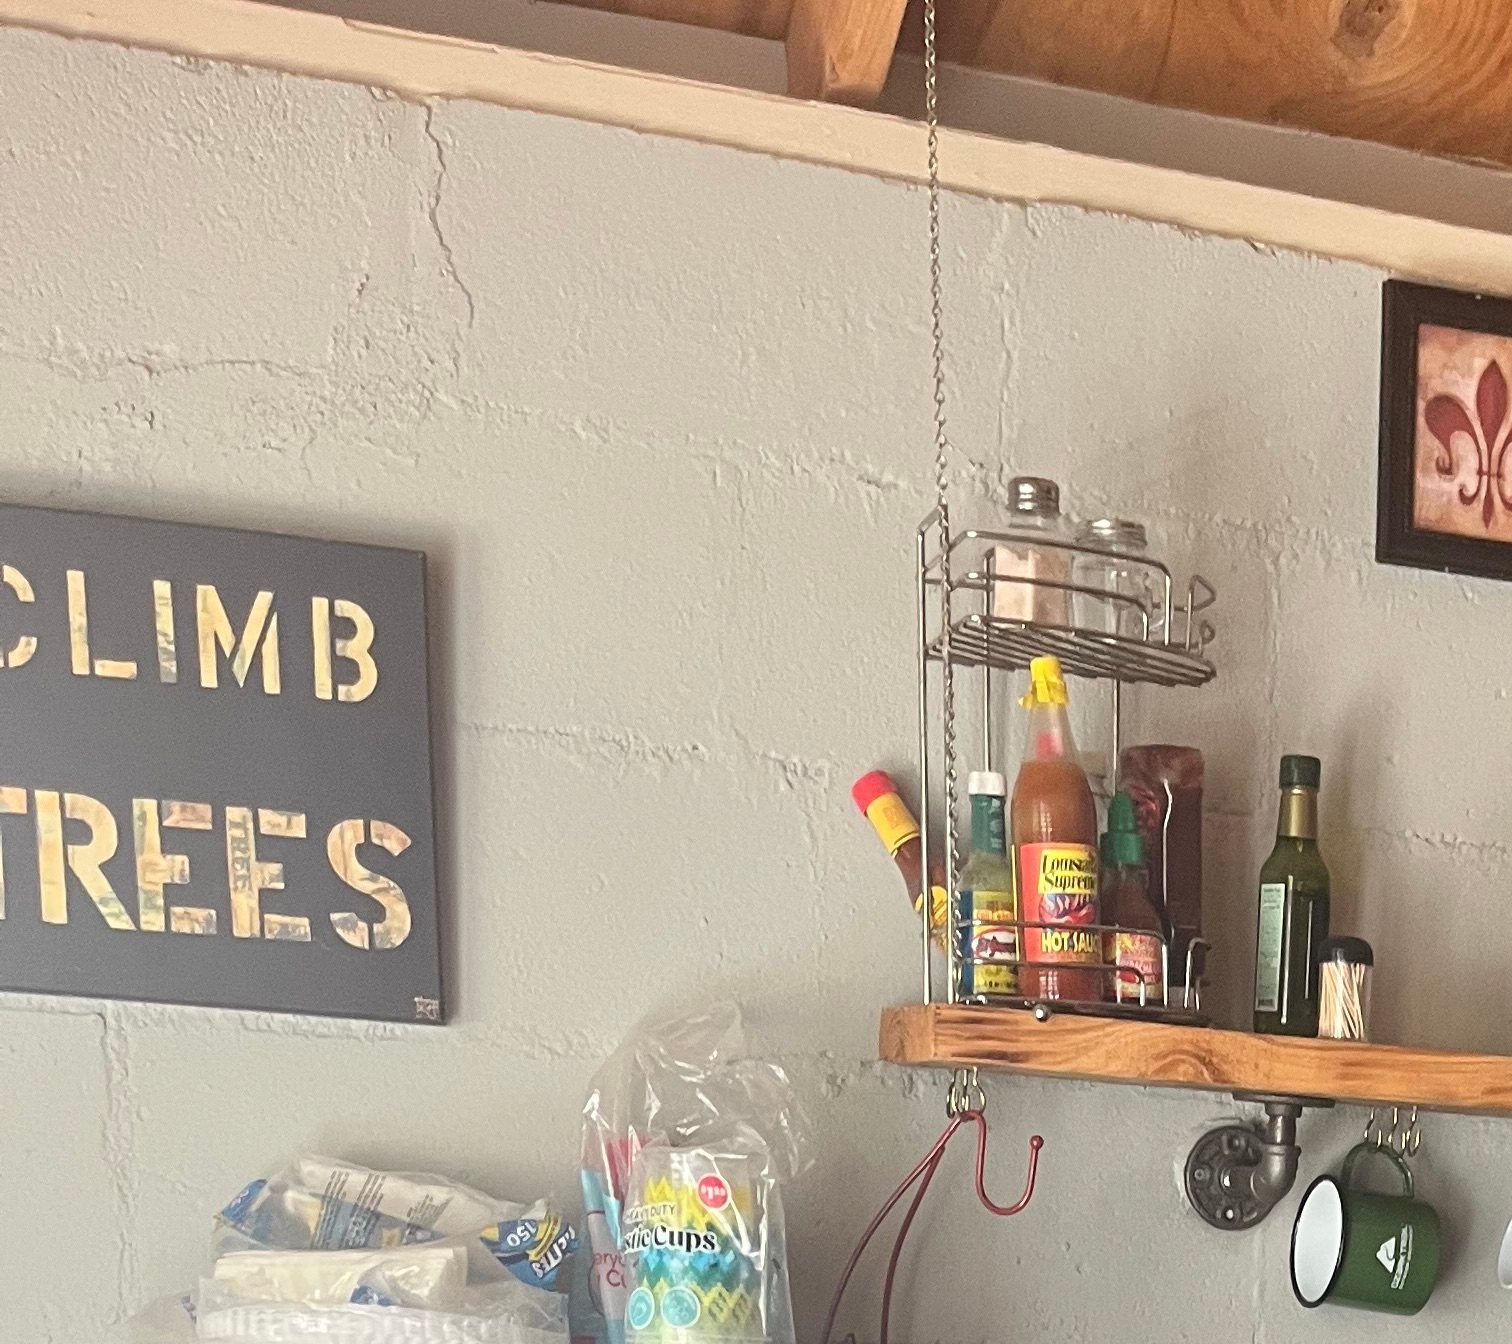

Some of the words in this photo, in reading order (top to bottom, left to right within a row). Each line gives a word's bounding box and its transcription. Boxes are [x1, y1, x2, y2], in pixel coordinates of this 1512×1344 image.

[0, 564, 379, 703] CLIMB
[1044, 871, 1096, 892] Suprem
[1041, 930, 1070, 953] HOT
[1072, 931, 1101, 953] SAUC
[653, 1224, 718, 1253] Cups
